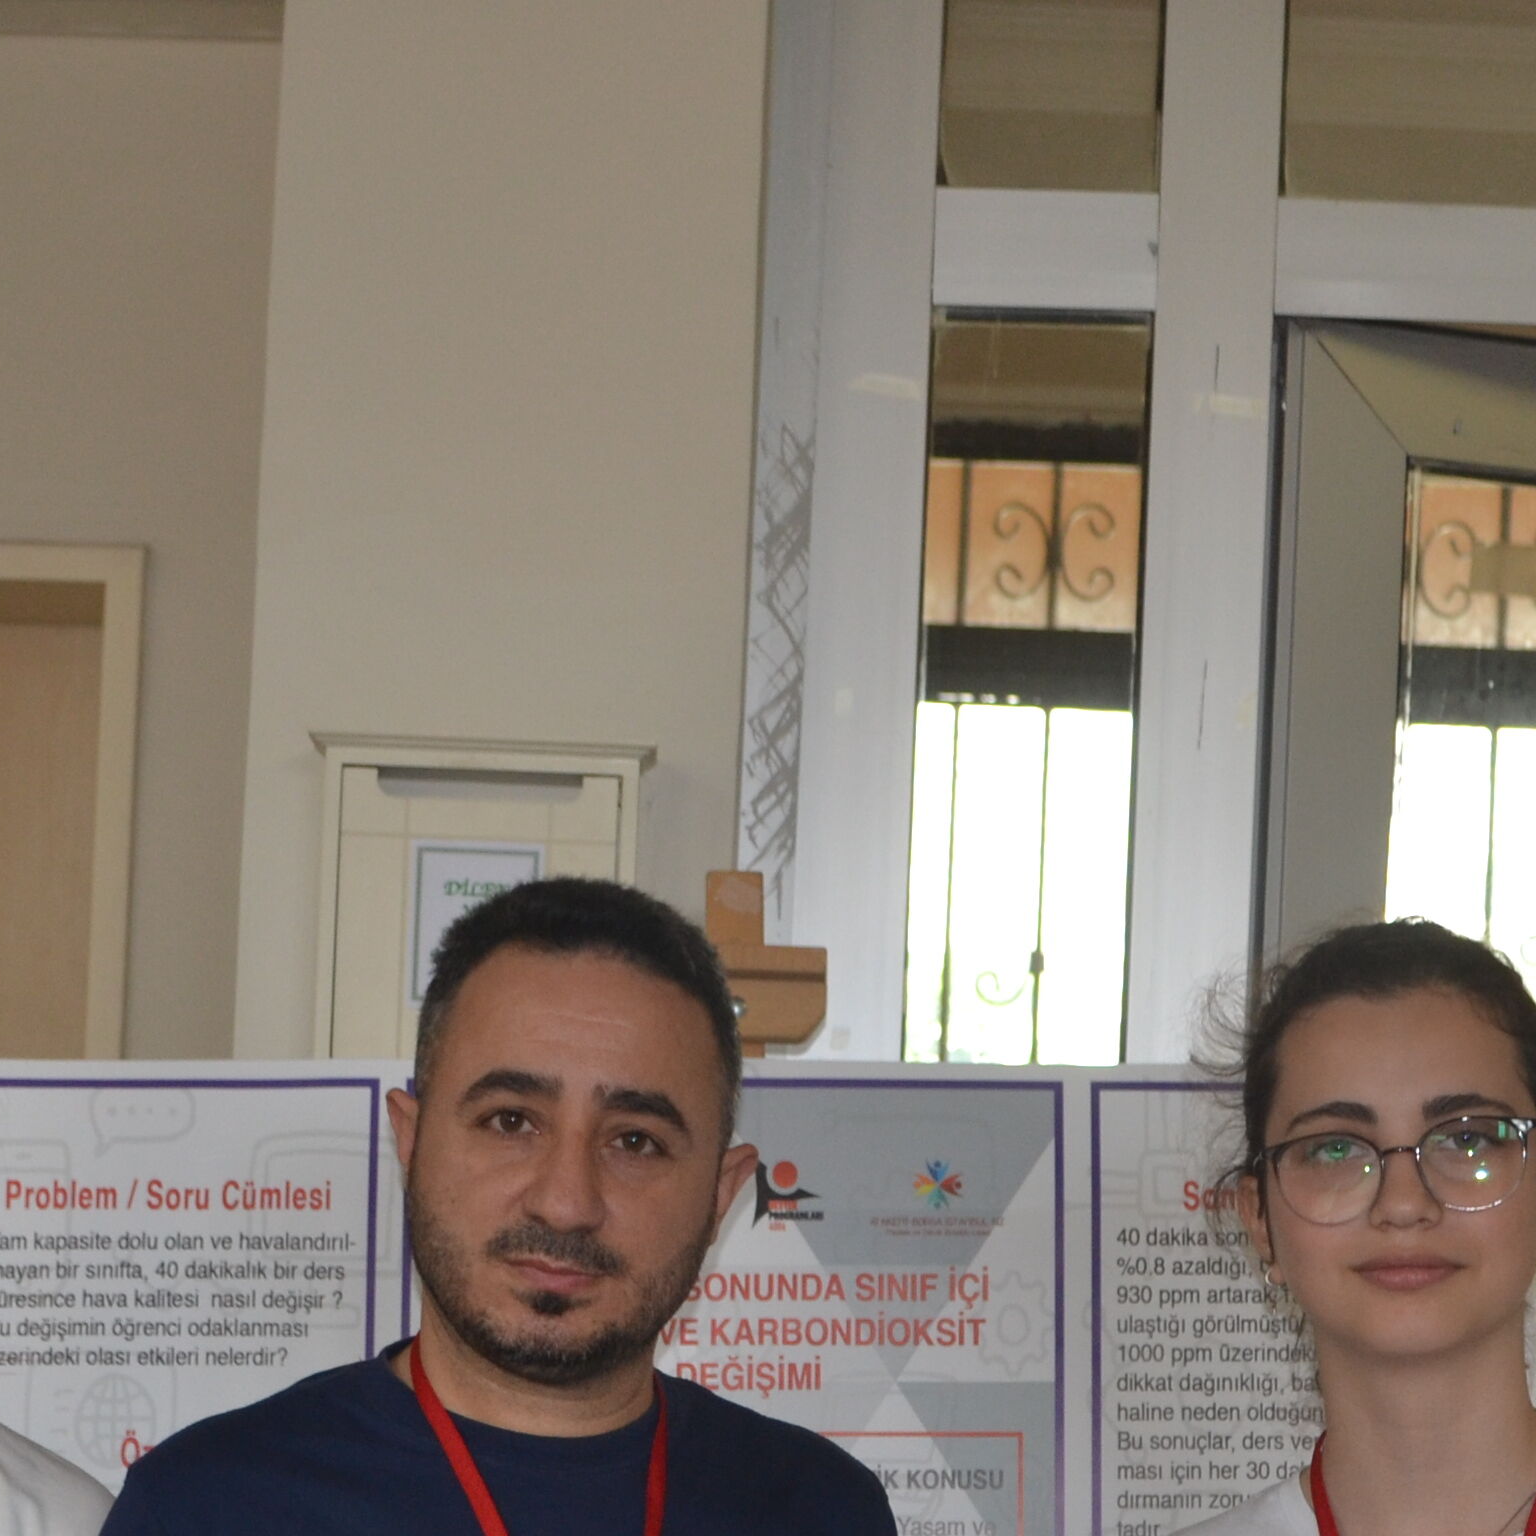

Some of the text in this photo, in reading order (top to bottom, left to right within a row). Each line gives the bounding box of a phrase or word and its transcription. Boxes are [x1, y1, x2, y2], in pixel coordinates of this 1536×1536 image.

[5, 1179, 118, 1210] Problem
[146, 1180, 209, 1210] Soru
[221, 1179, 332, 1211] Cümlesi
[33, 1231, 112, 1259] kapasite
[118, 1231, 158, 1250] dolu
[164, 1231, 204, 1250] olan
[209, 1235, 232, 1250] ve
[1116, 1228, 1209, 1247] 40 dakika
[56, 1261, 77, 1280] bir
[85, 1261, 148, 1282] sınıfta,
[155, 1261, 179, 1280] 40
[185, 1261, 266, 1280] dakikalık
[273, 1261, 297, 1280] bir
[303, 1261, 345, 1280] ders
[855, 1266, 990, 1309] SINIF İÇİ
[1116, 1287, 1153, 1305] 930
[1159, 1291, 1201, 1311] ppm
[82, 1290, 128, 1308] hava
[134, 1290, 200, 1309] kalitesi
[211, 1290, 256, 1308] nasıl
[262, 1290, 325, 1315] değişir
[16, 1319, 106, 1342] değişimin
[112, 1319, 182, 1343] öğrenci
[188, 1319, 308, 1338] odaklanması
[710, 1311, 986, 1347] KARBONDİOKSİT
[1116, 1315, 1186, 1338] ulaştığı
[86, 1347, 131, 1366] olası
[137, 1347, 199, 1366] etkileri
[205, 1347, 287, 1367] nelerdir?
[1117, 1345, 1212, 1368] 1000 ppm
[676, 1355, 823, 1399] DEĞİŞİMİ
[1116, 1373, 1173, 1392] dikkat
[1116, 1403, 1241, 1422] haline neden
[1117, 1432, 1143, 1451] Bu
[1242, 1432, 1284, 1451] ders
[907, 1468, 1005, 1490] KONUSU
[1117, 1461, 1270, 1485] ması için her 30
[1116, 1491, 1202, 1509] dırmanın
